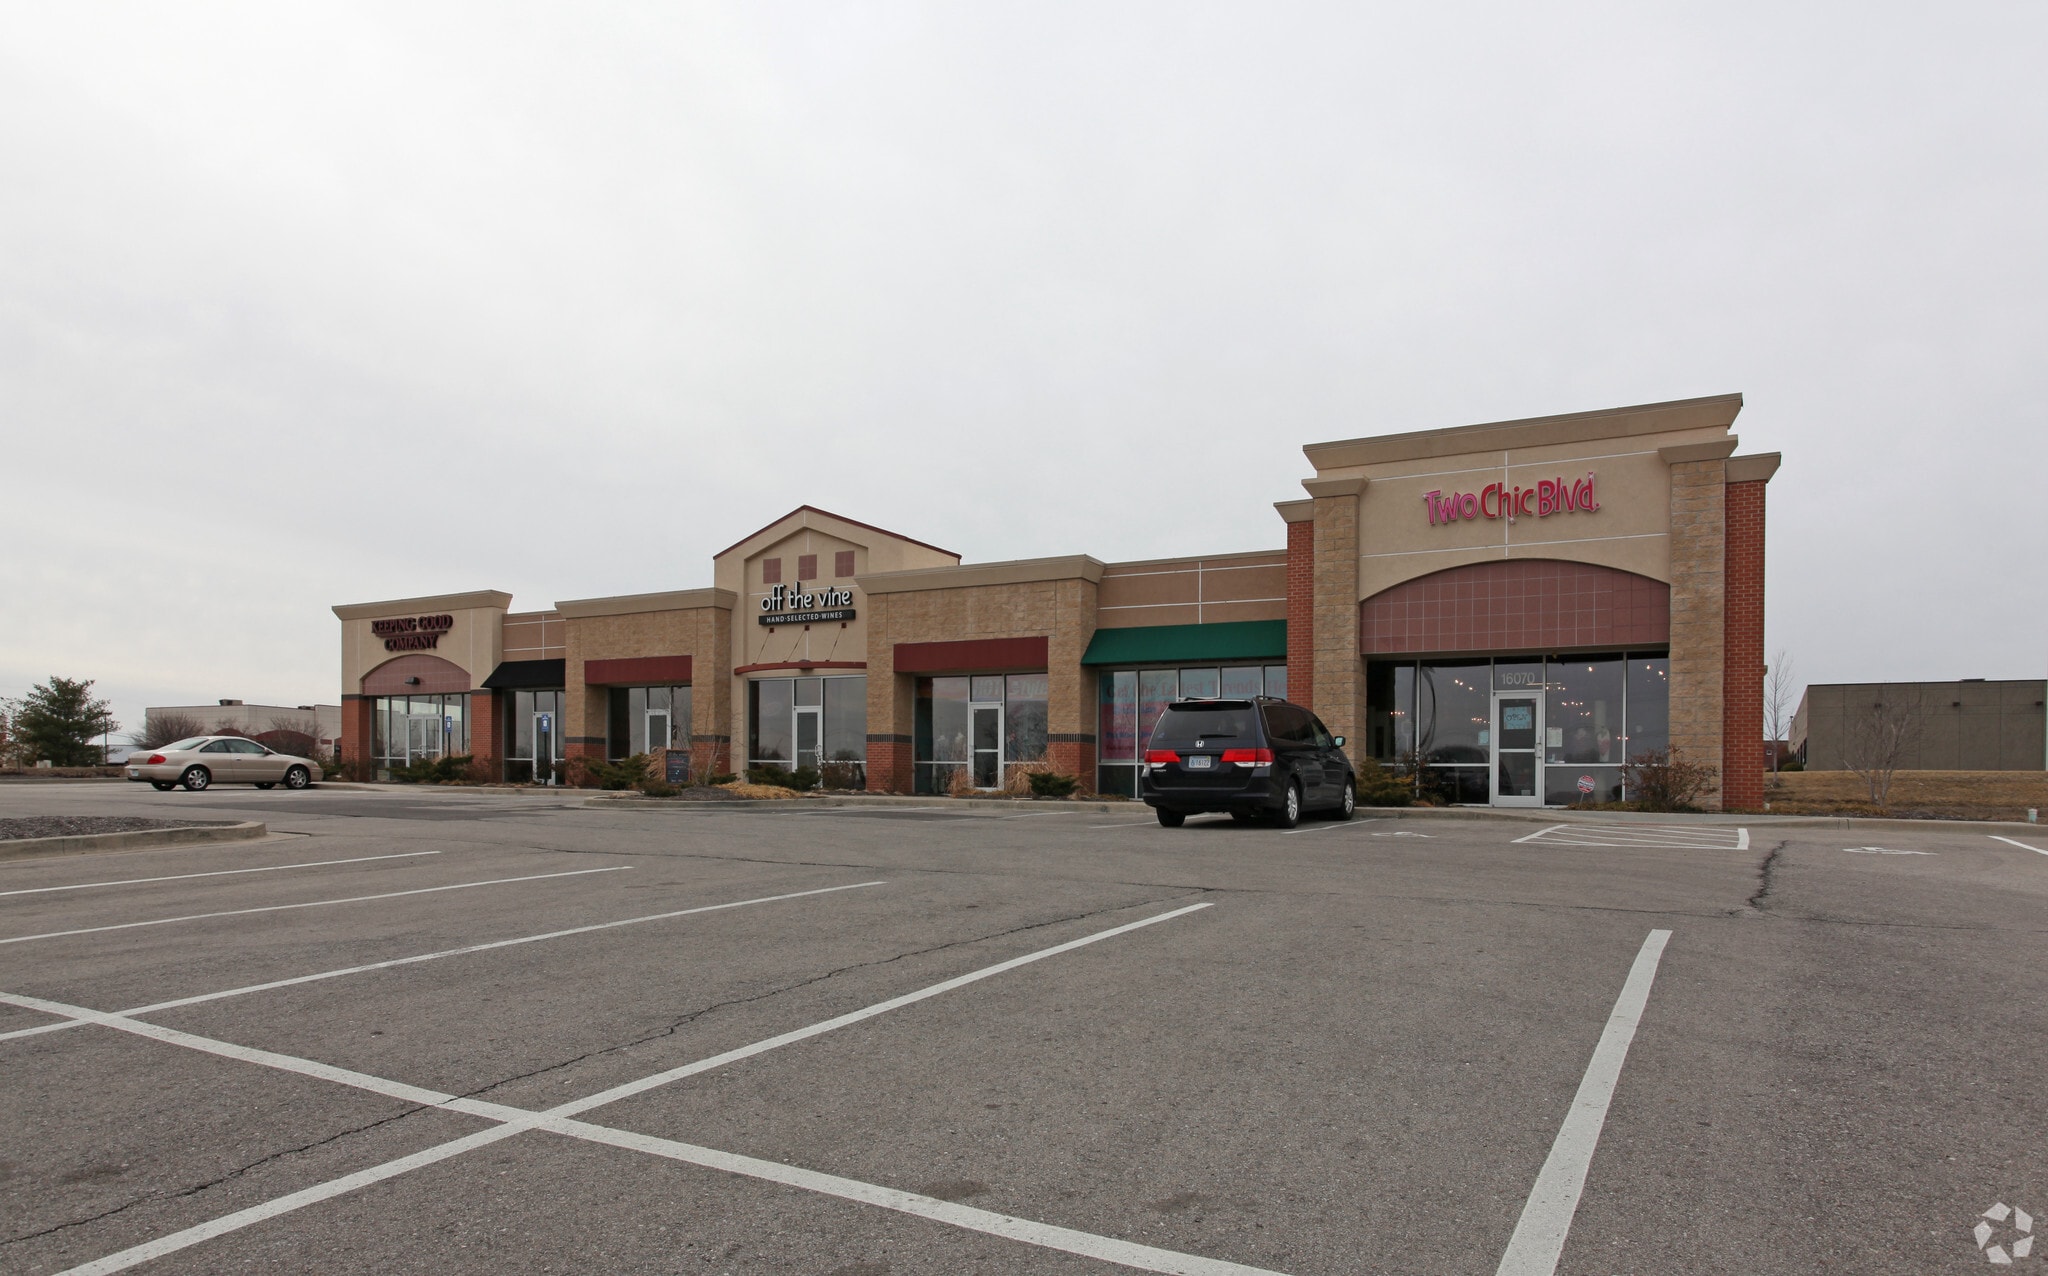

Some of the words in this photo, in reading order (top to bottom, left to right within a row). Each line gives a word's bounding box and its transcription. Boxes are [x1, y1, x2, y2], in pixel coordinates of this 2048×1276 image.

[1423, 490, 1479, 525] Two
[1480, 482, 1534, 525] Chic
[761, 584, 787, 612] off
[788, 581, 814, 610] the
[817, 586, 853, 607] vine
[371, 617, 417, 634] KEEPING
[417, 614, 454, 631] GOOD
[821, 611, 843, 619] WINES
[384, 633, 440, 651] COMPANY
[1501, 672, 1536, 685] 16070
